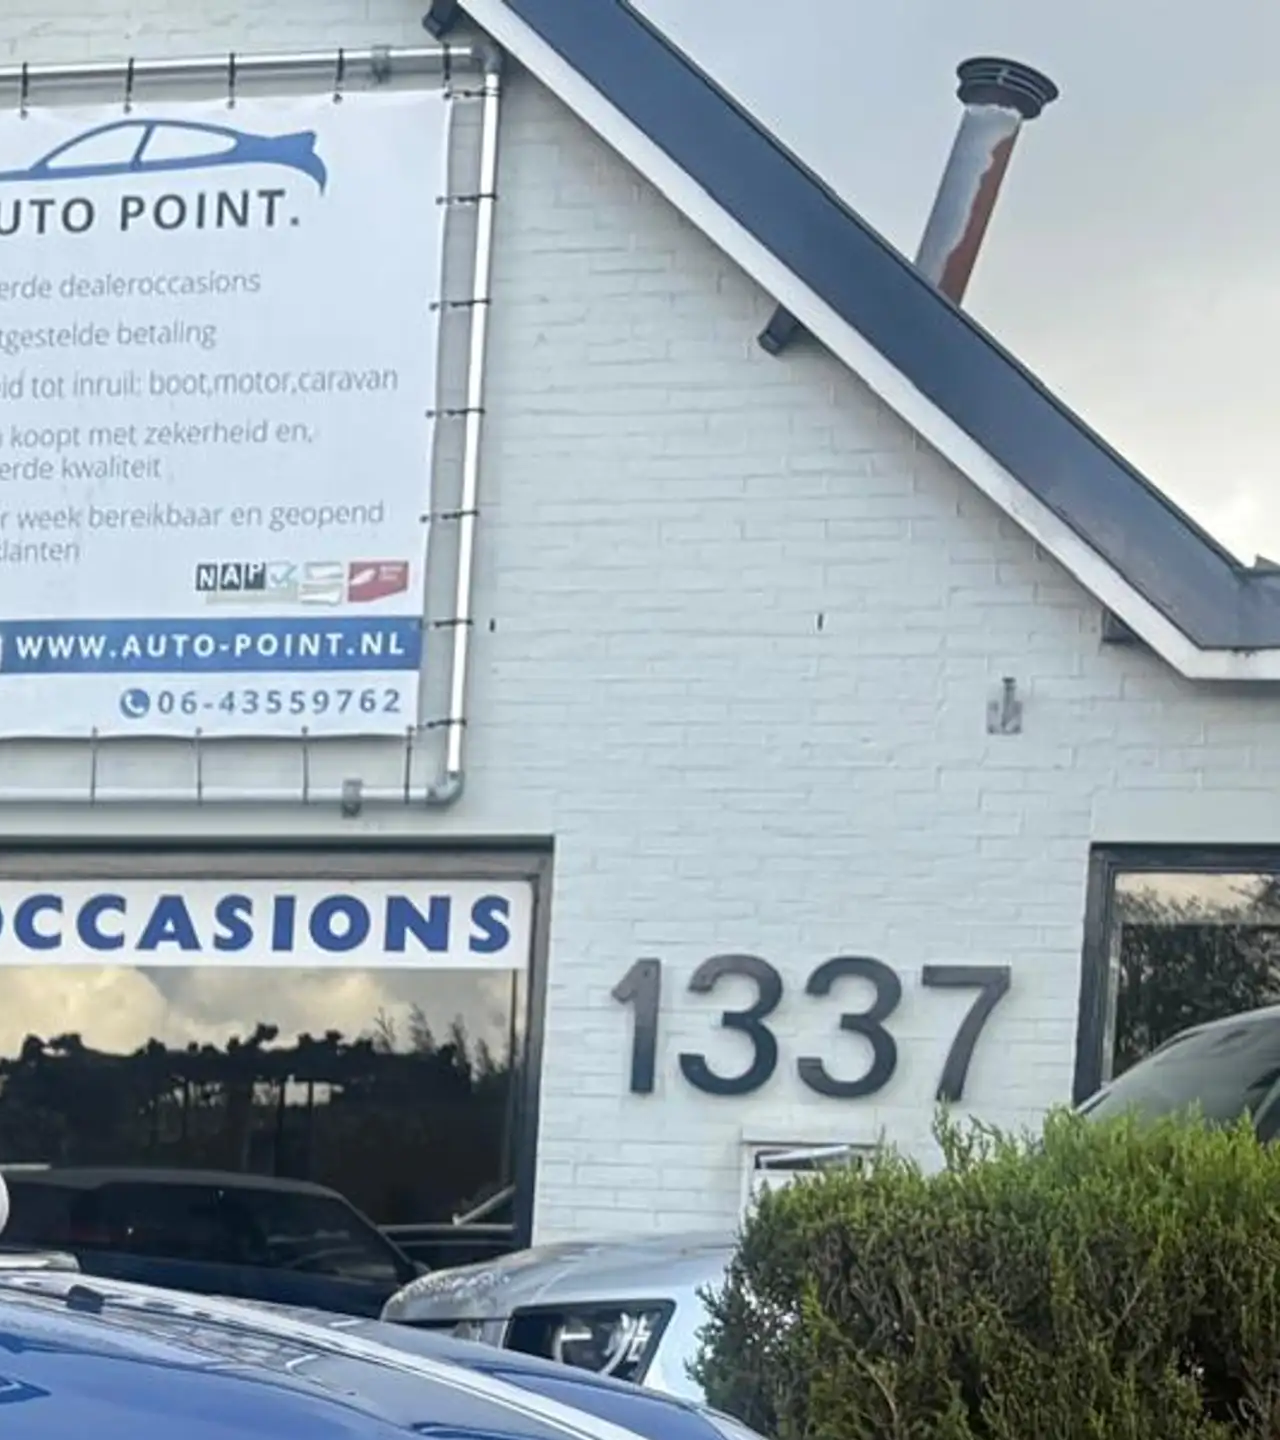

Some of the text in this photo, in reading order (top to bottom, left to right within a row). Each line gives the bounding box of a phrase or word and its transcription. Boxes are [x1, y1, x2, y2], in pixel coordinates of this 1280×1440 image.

[120, 189, 300, 232] POINT.
[59, 270, 261, 299] dealeroccasions
[116, 319, 217, 350] betaling
[32, 376, 64, 399] tot
[10, 424, 80, 453] koopt
[89, 423, 137, 446] met
[143, 418, 268, 445] zekerheid
[61, 454, 162, 480] kwaliteit
[17, 506, 82, 530] week
[88, 502, 224, 530] bereikbaar
[230, 506, 263, 526] en
[268, 500, 384, 532] geopend
[197, 563, 266, 592] NAP
[16, 631, 405, 659] WWW.AUTO-POINT.NL
[157, 688, 402, 715] 06-43559762
[610, 954, 1012, 1103] 1337
